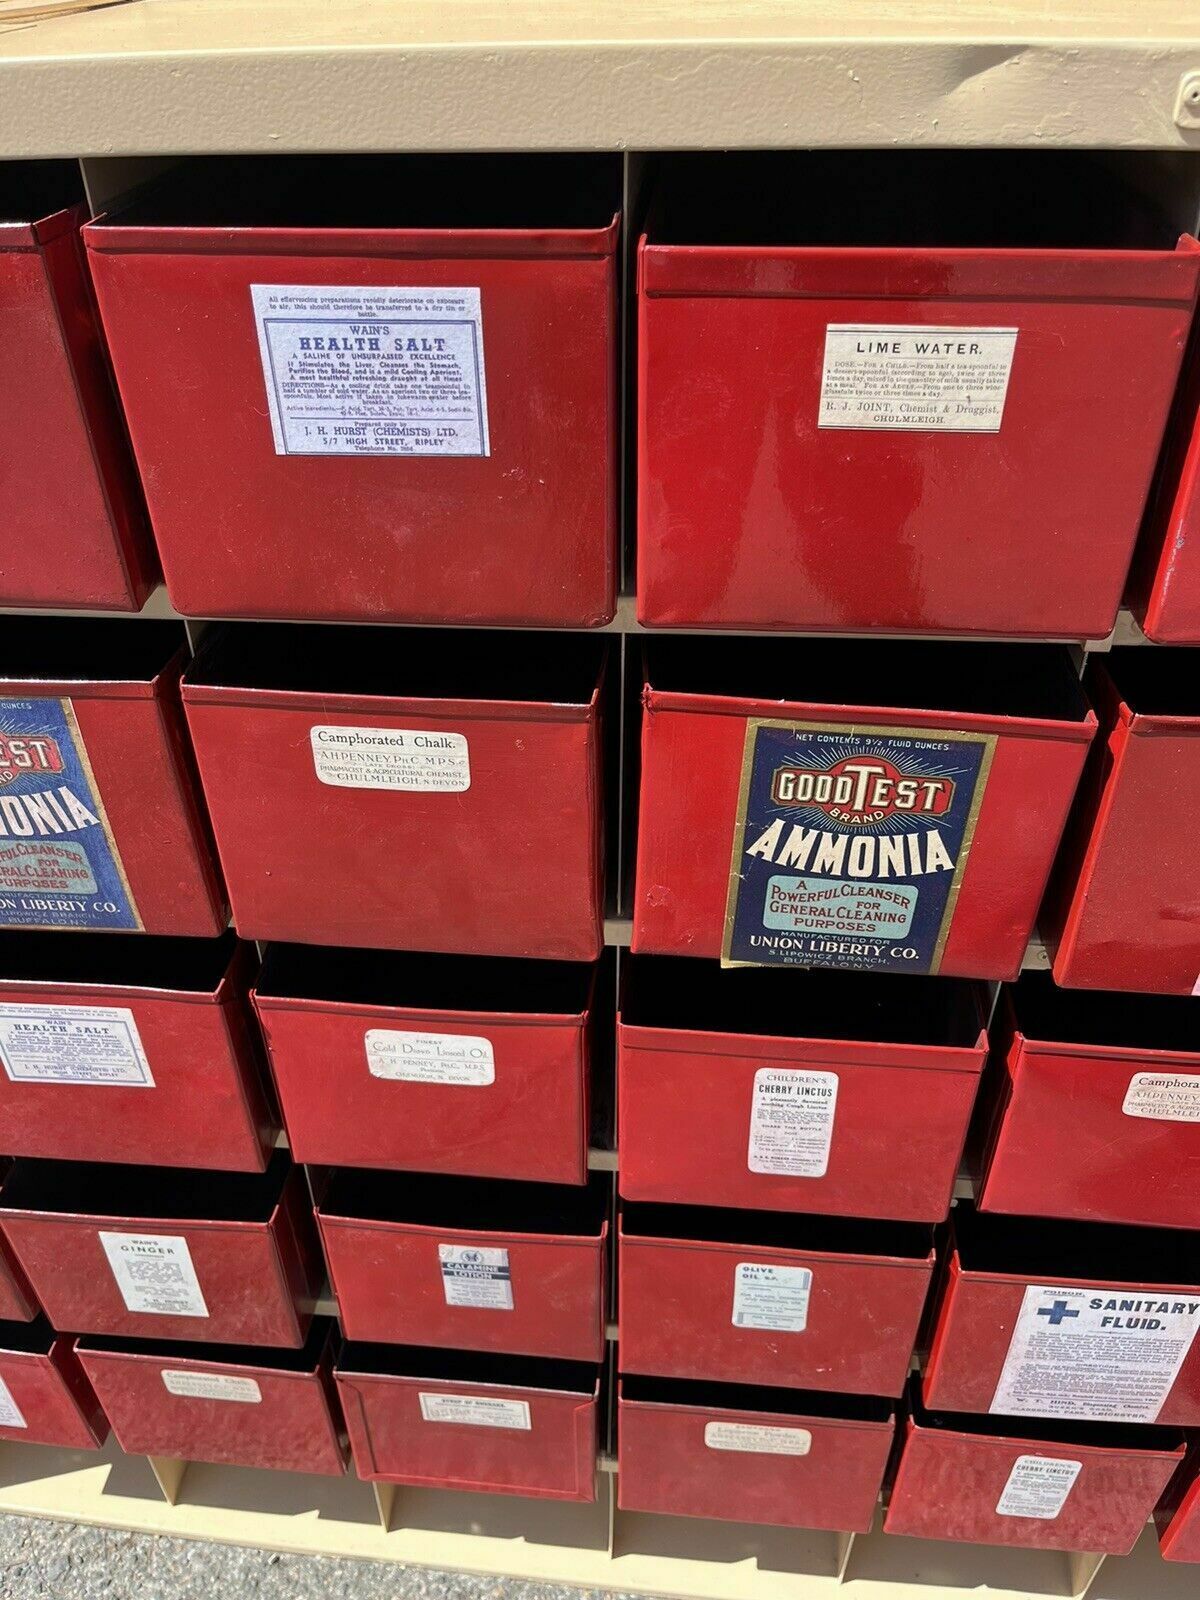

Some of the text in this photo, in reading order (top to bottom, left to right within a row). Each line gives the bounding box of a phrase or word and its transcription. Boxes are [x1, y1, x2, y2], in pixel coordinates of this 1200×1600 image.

[350, 326, 390, 335] WAIN'S
[300, 337, 445, 351] HEALTH SALT
[857, 342, 983, 355] LIME WATER.
[857, 403, 893, 413] JOINT,
[900, 404, 937, 413] Chemist
[318, 427, 328, 435] H.
[334, 427, 367, 436] HURST
[373, 427, 431, 437] (CHEMISTS)
[437, 428, 458, 437] LTD.
[1, 702, 32, 710] OUNCES
[318, 731, 456, 749] Camphorated Chalk.
[796, 733, 814, 742] NET
[817, 734, 860, 745] CONTENTS
[888, 739, 911, 748] FLUID
[915, 742, 949, 751] OUNCES
[829, 808, 885, 824] BRAND
[16, 842, 83, 863] CLEANSER
[746, 819, 955, 879] AMMONIA
[38, 859, 60, 867] FOR
[25, 864, 89, 879] CLEANING
[796, 881, 807, 890] A
[770, 884, 911, 910] POWERFUL CLEANSER
[21, 899, 87, 912] LIBERTY
[93, 902, 121, 913] CO.
[857, 901, 881, 910] FOR
[770, 901, 907, 924] GENERAL CLEANING
[794, 917, 876, 932] PURPOSES
[780, 931, 866, 944] MANUFACTURED
[750, 936, 919, 960] UNION LIBERTY CO.
[13, 1024, 67, 1032] HEALTH
[767, 1075, 827, 1084] CHILDREN'S
[759, 1085, 832, 1097] CHERRY LINCTUS
[121, 1246, 175, 1255] GINGER
[447, 1263, 498, 1272] CALAMINE
[454, 1271, 492, 1279] LOTION
[1089, 1298, 1200, 1315] SANITARY
[1101, 1317, 1167, 1331] FLUID.
